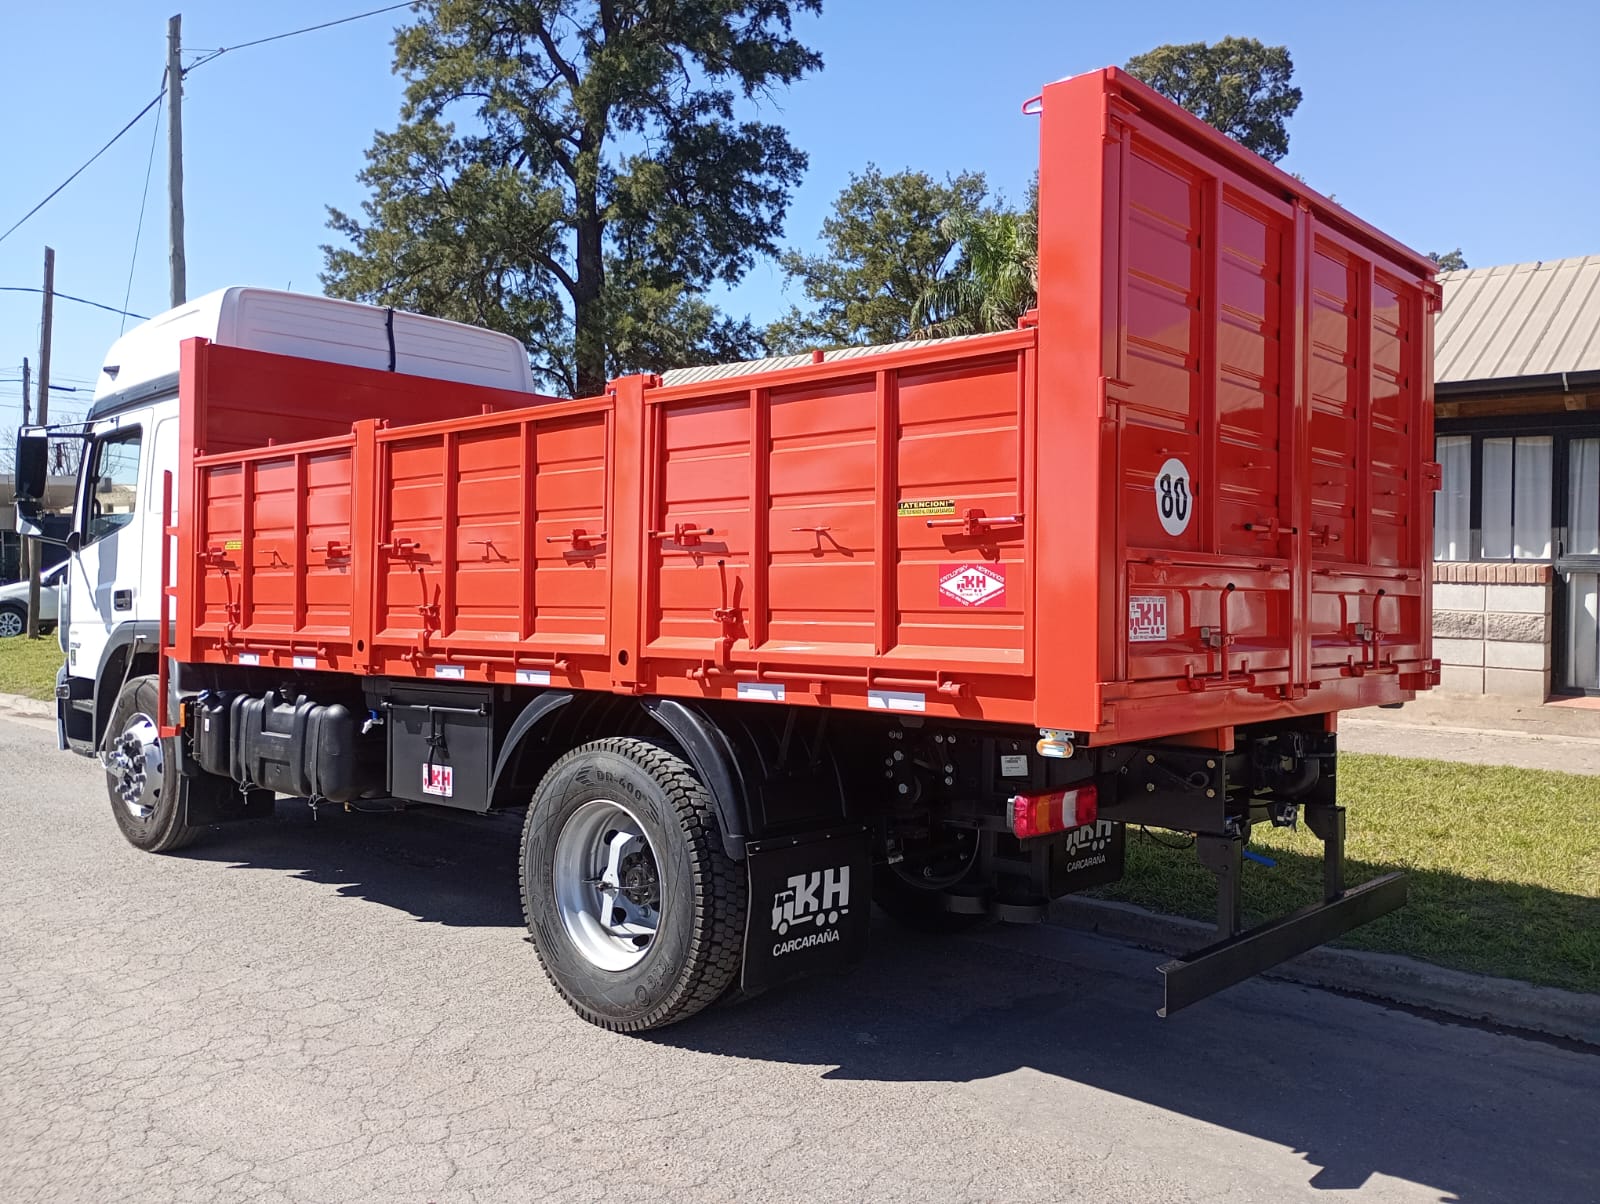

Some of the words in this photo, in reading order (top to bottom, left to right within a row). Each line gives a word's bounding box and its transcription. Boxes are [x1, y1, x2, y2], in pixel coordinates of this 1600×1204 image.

[1159, 473, 1187, 521] 80
[1066, 852, 1106, 873] CARCARAÑA
[787, 865, 850, 917] KH
[772, 928, 840, 957] CARCARAÑA
